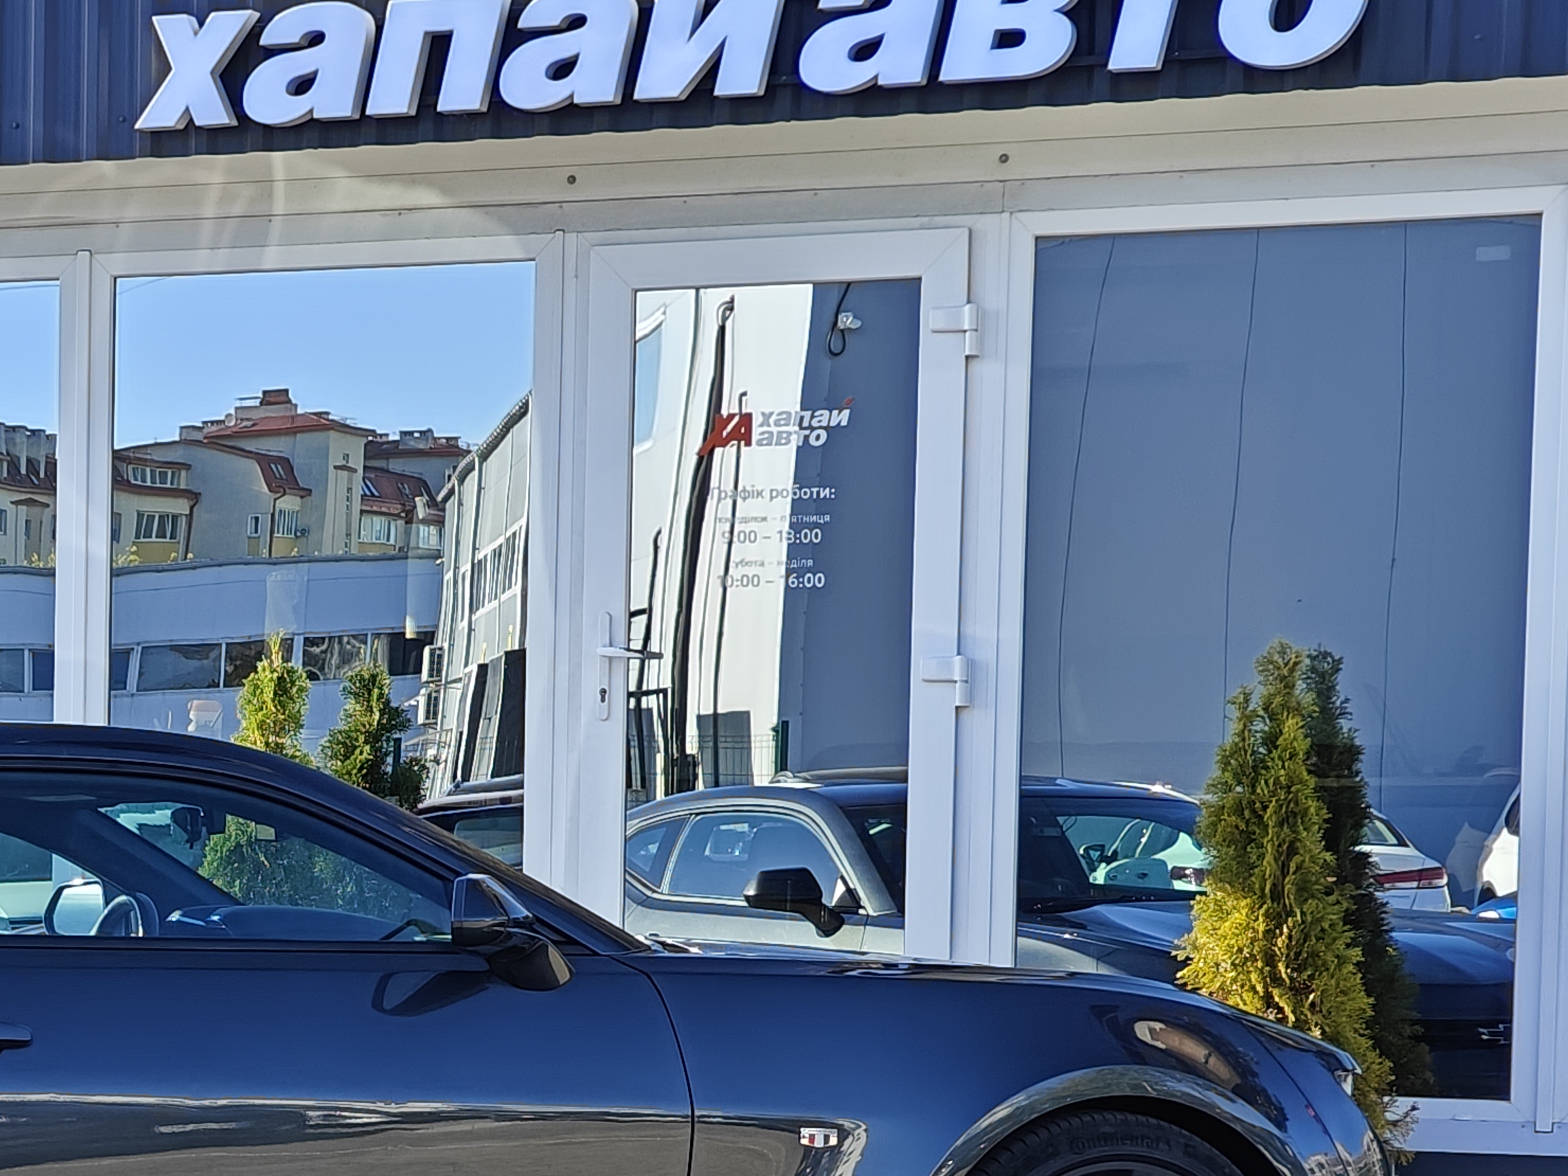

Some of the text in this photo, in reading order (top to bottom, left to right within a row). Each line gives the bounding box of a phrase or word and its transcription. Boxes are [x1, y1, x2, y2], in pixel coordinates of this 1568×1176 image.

[757, 397, 854, 428] хапай
[756, 429, 828, 447] авто
[710, 484, 836, 502] Графік роботи:
